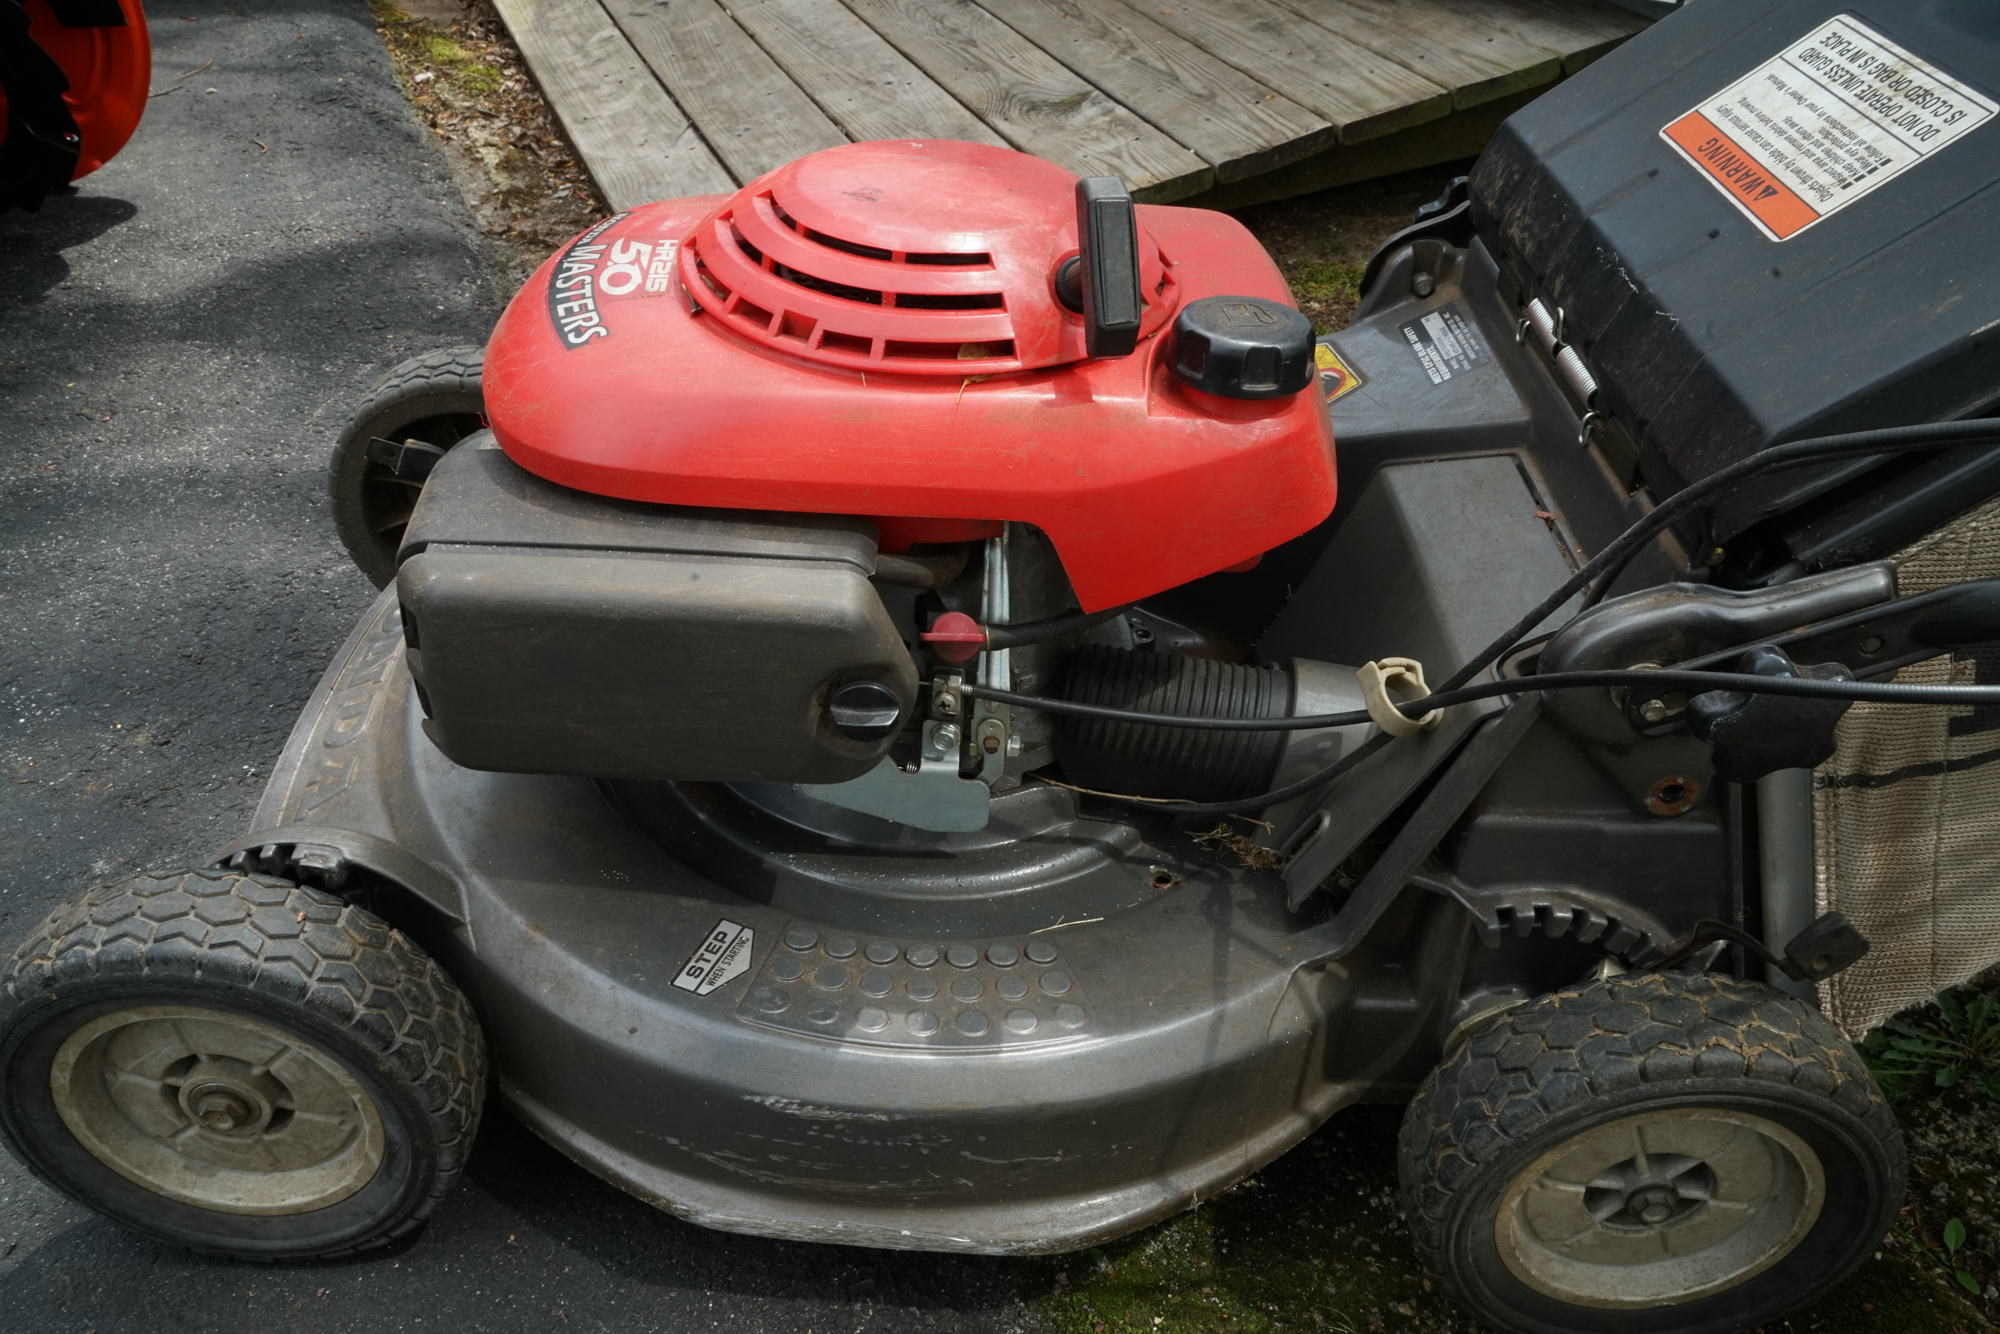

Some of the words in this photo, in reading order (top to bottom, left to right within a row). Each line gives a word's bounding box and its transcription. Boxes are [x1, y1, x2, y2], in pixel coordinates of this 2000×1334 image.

[1818, 31, 1858, 57] PLACE
[1797, 46, 1833, 71] GUARD
[1845, 48, 1868, 64] IN
[1856, 55, 1879, 70] IS
[1822, 63, 1865, 93] UNLESS
[1866, 61, 1899, 83] BAG
[1763, 72, 1788, 91] Manual.
[1886, 73, 1913, 92] OR
[1783, 86, 1808, 105] Owner's
[1852, 83, 1904, 118] OPERATE
[1902, 84, 1954, 117] CLOSED
[1803, 101, 1824, 113] your
[1816, 110, 1827, 120] in
[1727, 114, 1750, 132] serious
[1753, 110, 1773, 127] before
[1781, 115, 1799, 129] away.
[1890, 110, 1925, 132] NOT
[1942, 109, 1968, 126] IS
[1743, 128, 1764, 143] cause
[1768, 122, 1788, 137] debris
[1794, 125, 1815, 141] others
[1822, 114, 1859, 143] instructions
[1912, 123, 1941, 142] DO
[1758, 139, 1774, 151] can
[1783, 133, 1809, 152] remove
[1807, 137, 1825, 149] and
[1843, 144, 1859, 157] eye
[1851, 137, 1867, 150] all
[1767, 147, 1788, 165] blade
[1798, 147, 1816, 159] and
[1811, 155, 1830, 169] area
[1820, 146, 1846, 165] children
[1862, 144, 1887, 163] Follow
[1697, 136, 1766, 195] WARNING
[1782, 158, 1796, 171] by
[1841, 162, 1864, 178] Keep
[1853, 154, 1878, 171] Wear
[1789, 165, 1813, 185] thrown
[1807, 179, 1834, 202] Objects
[577, 212, 629, 246] HONDA
[599, 237, 653, 296] 5.0
[645, 239, 679, 292] HR215
[556, 244, 608, 344] MASTERS
[1404, 327, 1419, 343] SAFETY
[1412, 341, 1426, 357] BLADE
[1420, 355, 1434, 369] CPSC
[1427, 344, 1452, 380] REQUIREMENTS.
[1427, 367, 1442, 384] MEETS
[685, 930, 728, 979] STEP
[705, 965, 727, 987] WHEN
[721, 936, 750, 967] STARTING
